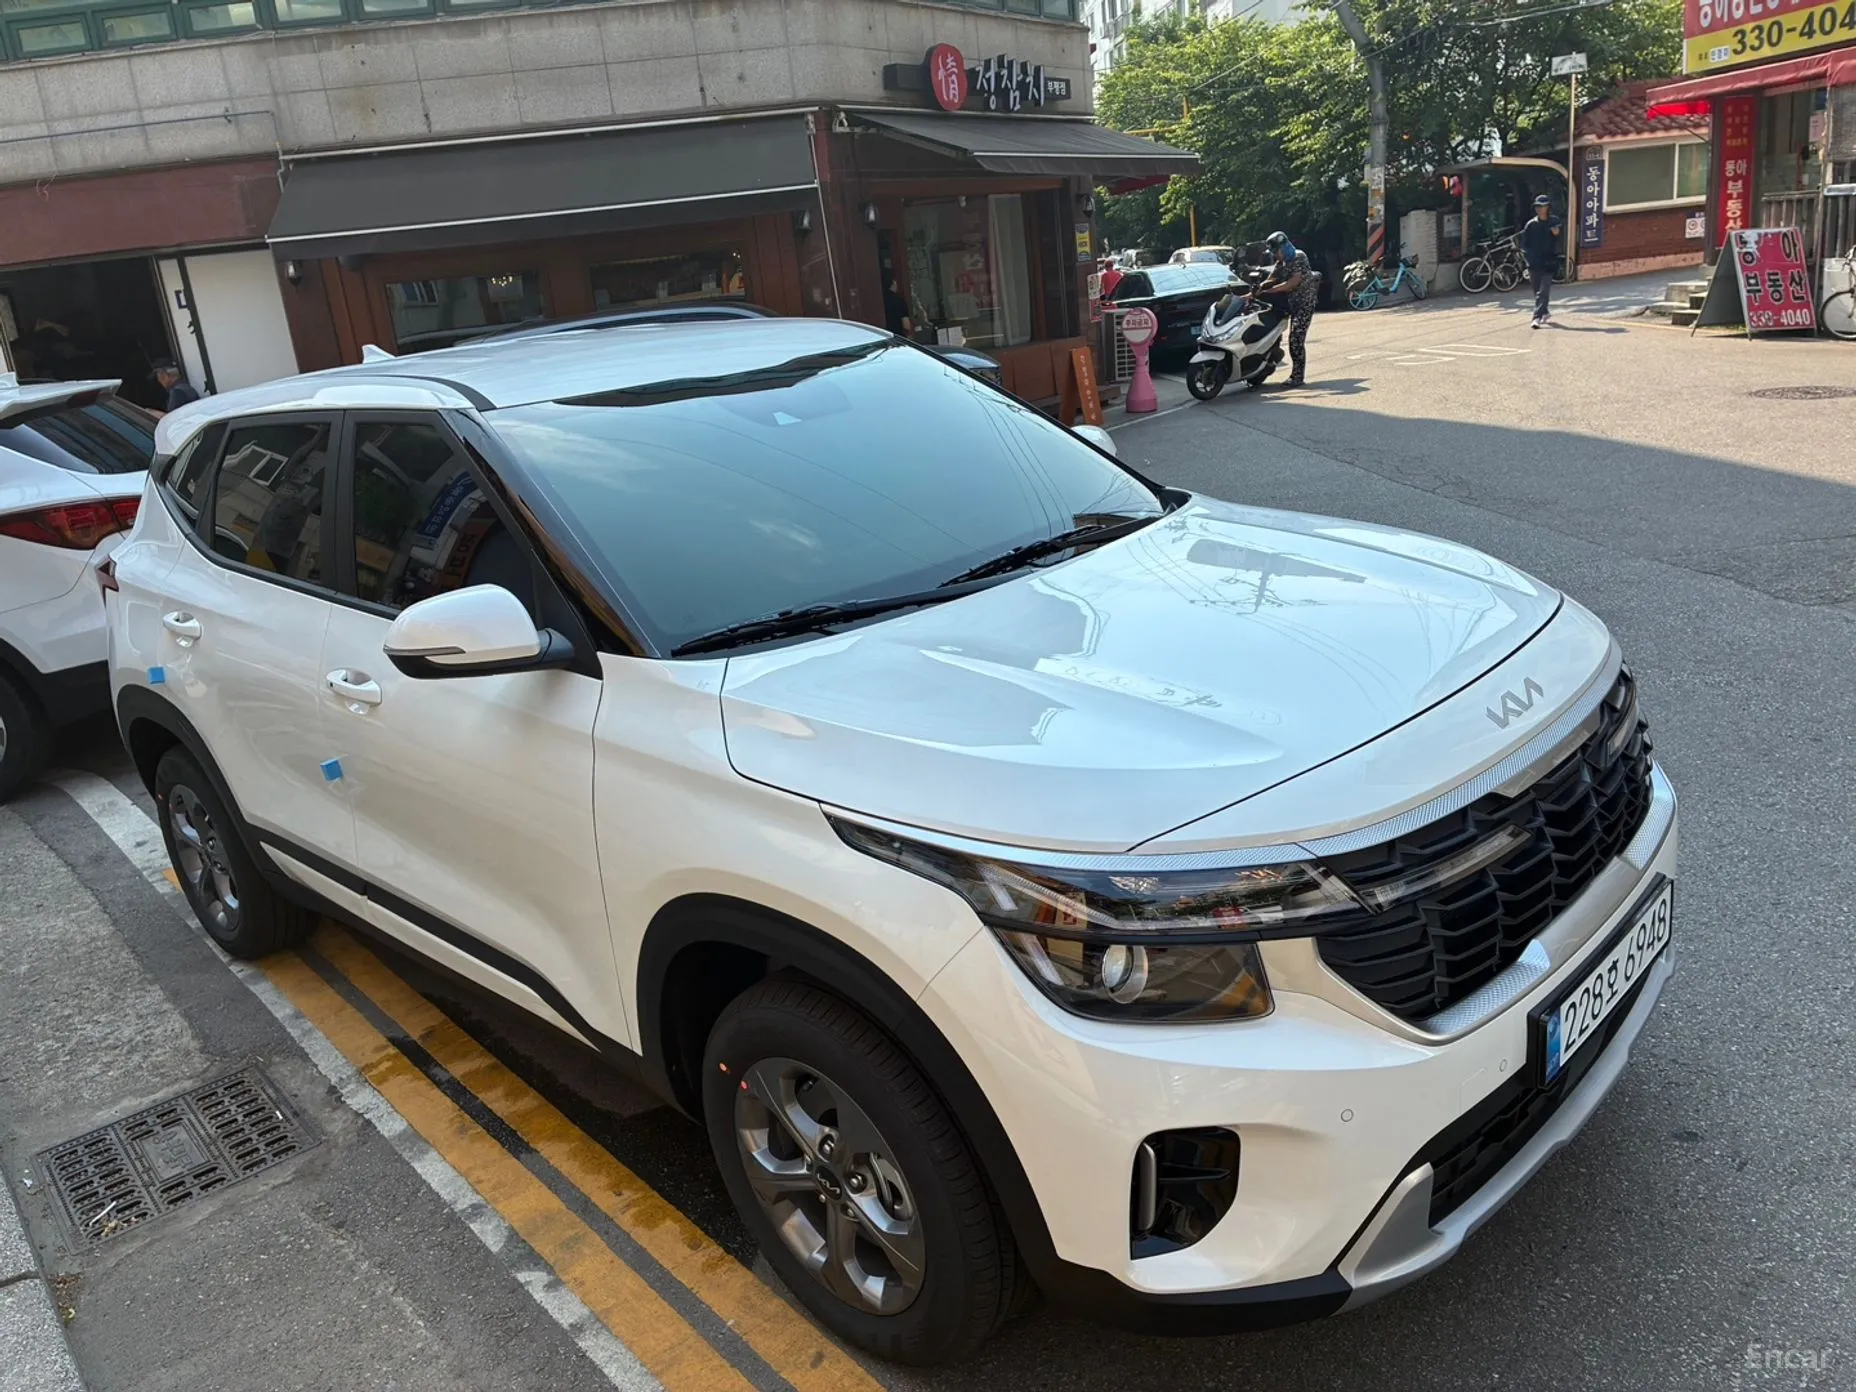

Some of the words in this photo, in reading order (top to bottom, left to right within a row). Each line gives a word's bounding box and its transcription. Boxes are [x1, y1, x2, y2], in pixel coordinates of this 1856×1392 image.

[975, 53, 1045, 112] 정참치
[1047, 80, 1067, 96] 부평점
[1725, 159, 1747, 178] 동아
[1744, 270, 1807, 305] 부동산
[1486, 676, 1544, 729] KIA
[1563, 958, 1620, 1053] 228호
[1624, 898, 1667, 982] 6948
